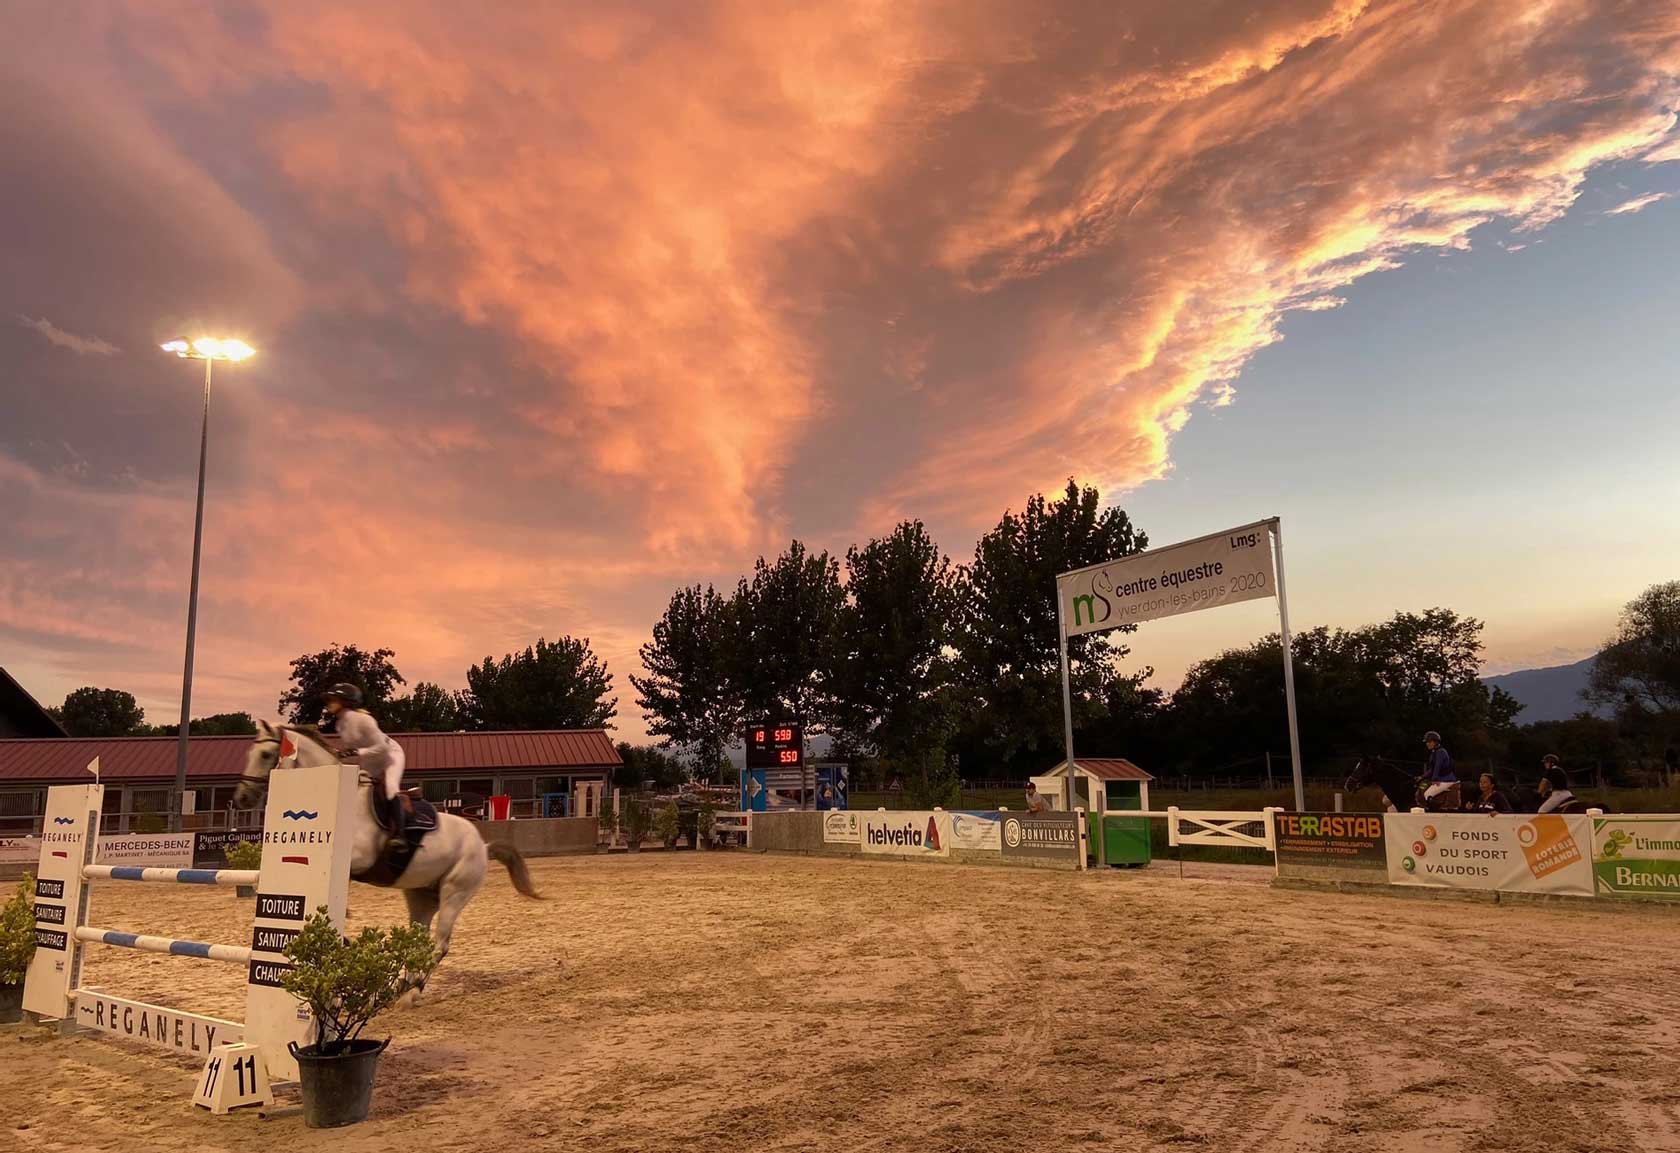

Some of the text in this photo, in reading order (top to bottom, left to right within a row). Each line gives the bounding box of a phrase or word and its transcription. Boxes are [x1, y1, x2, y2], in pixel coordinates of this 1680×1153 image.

[1230, 532, 1261, 549] Lmg:
[1115, 561, 1223, 598] centre équestre
[1117, 571, 1266, 620] yverdon-les-bains 2020
[755, 731, 765, 742] 19
[867, 822, 922, 846] helvetia
[1021, 828, 1075, 841] BONVILLARS
[1276, 815, 1381, 838] TERRASTAB
[199, 832, 262, 843] Piguet Galland
[264, 831, 332, 844] REGANELY
[1452, 831, 1499, 841] FONDS
[104, 839, 191, 851] MERCEDES-BENZ
[1535, 837, 1576, 861] LOTERIE
[1440, 848, 1508, 860] DU SPORT
[1530, 847, 1579, 874] ROMANDE
[1426, 864, 1489, 876] VAUDOIS
[1616, 866, 1680, 887] BERNA
[39, 882, 62, 896] TOITURE
[36, 906, 63, 921] SANITAIRE
[261, 898, 300, 916] TOITURE
[96, 1000, 216, 1054] REGANELY
[203, 1054, 257, 1098] 11 11
